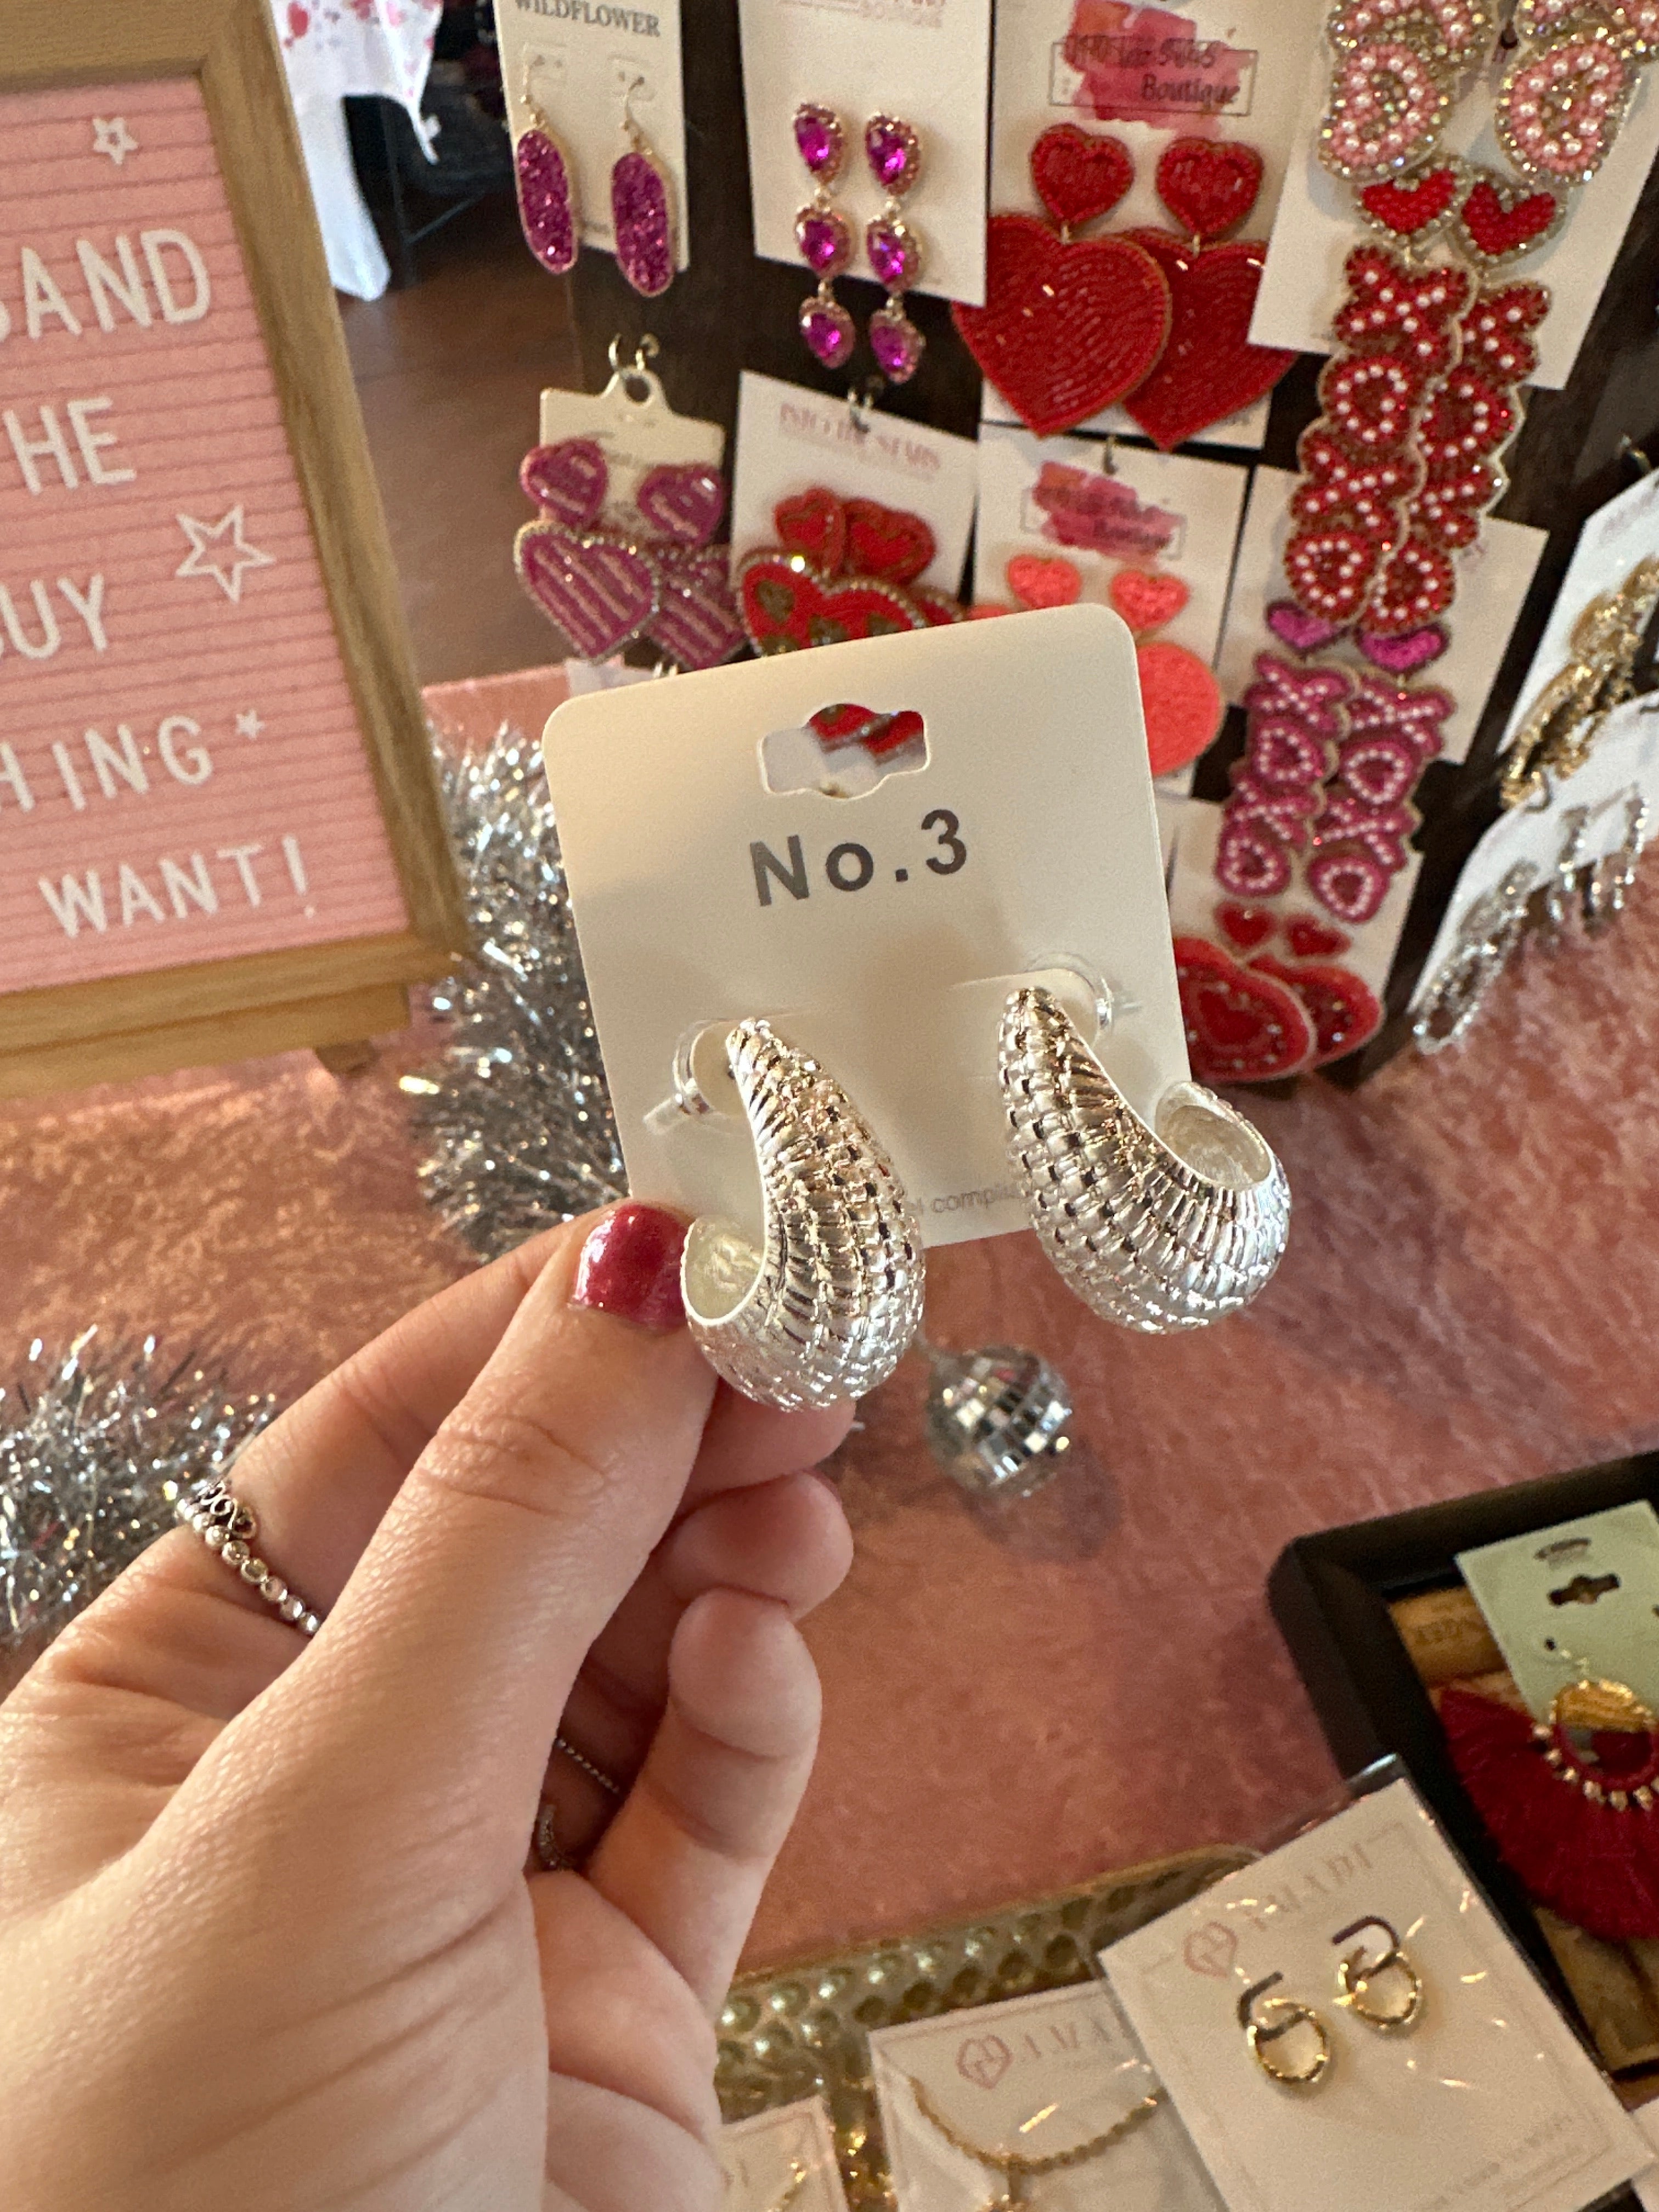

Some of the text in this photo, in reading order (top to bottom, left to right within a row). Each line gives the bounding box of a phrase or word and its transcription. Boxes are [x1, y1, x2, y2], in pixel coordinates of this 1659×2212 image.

[0, 228, 211, 341] AND
[0, 573, 108, 659] UY
[40, 834, 317, 939] WANT!
[749, 809, 968, 907] No.3
